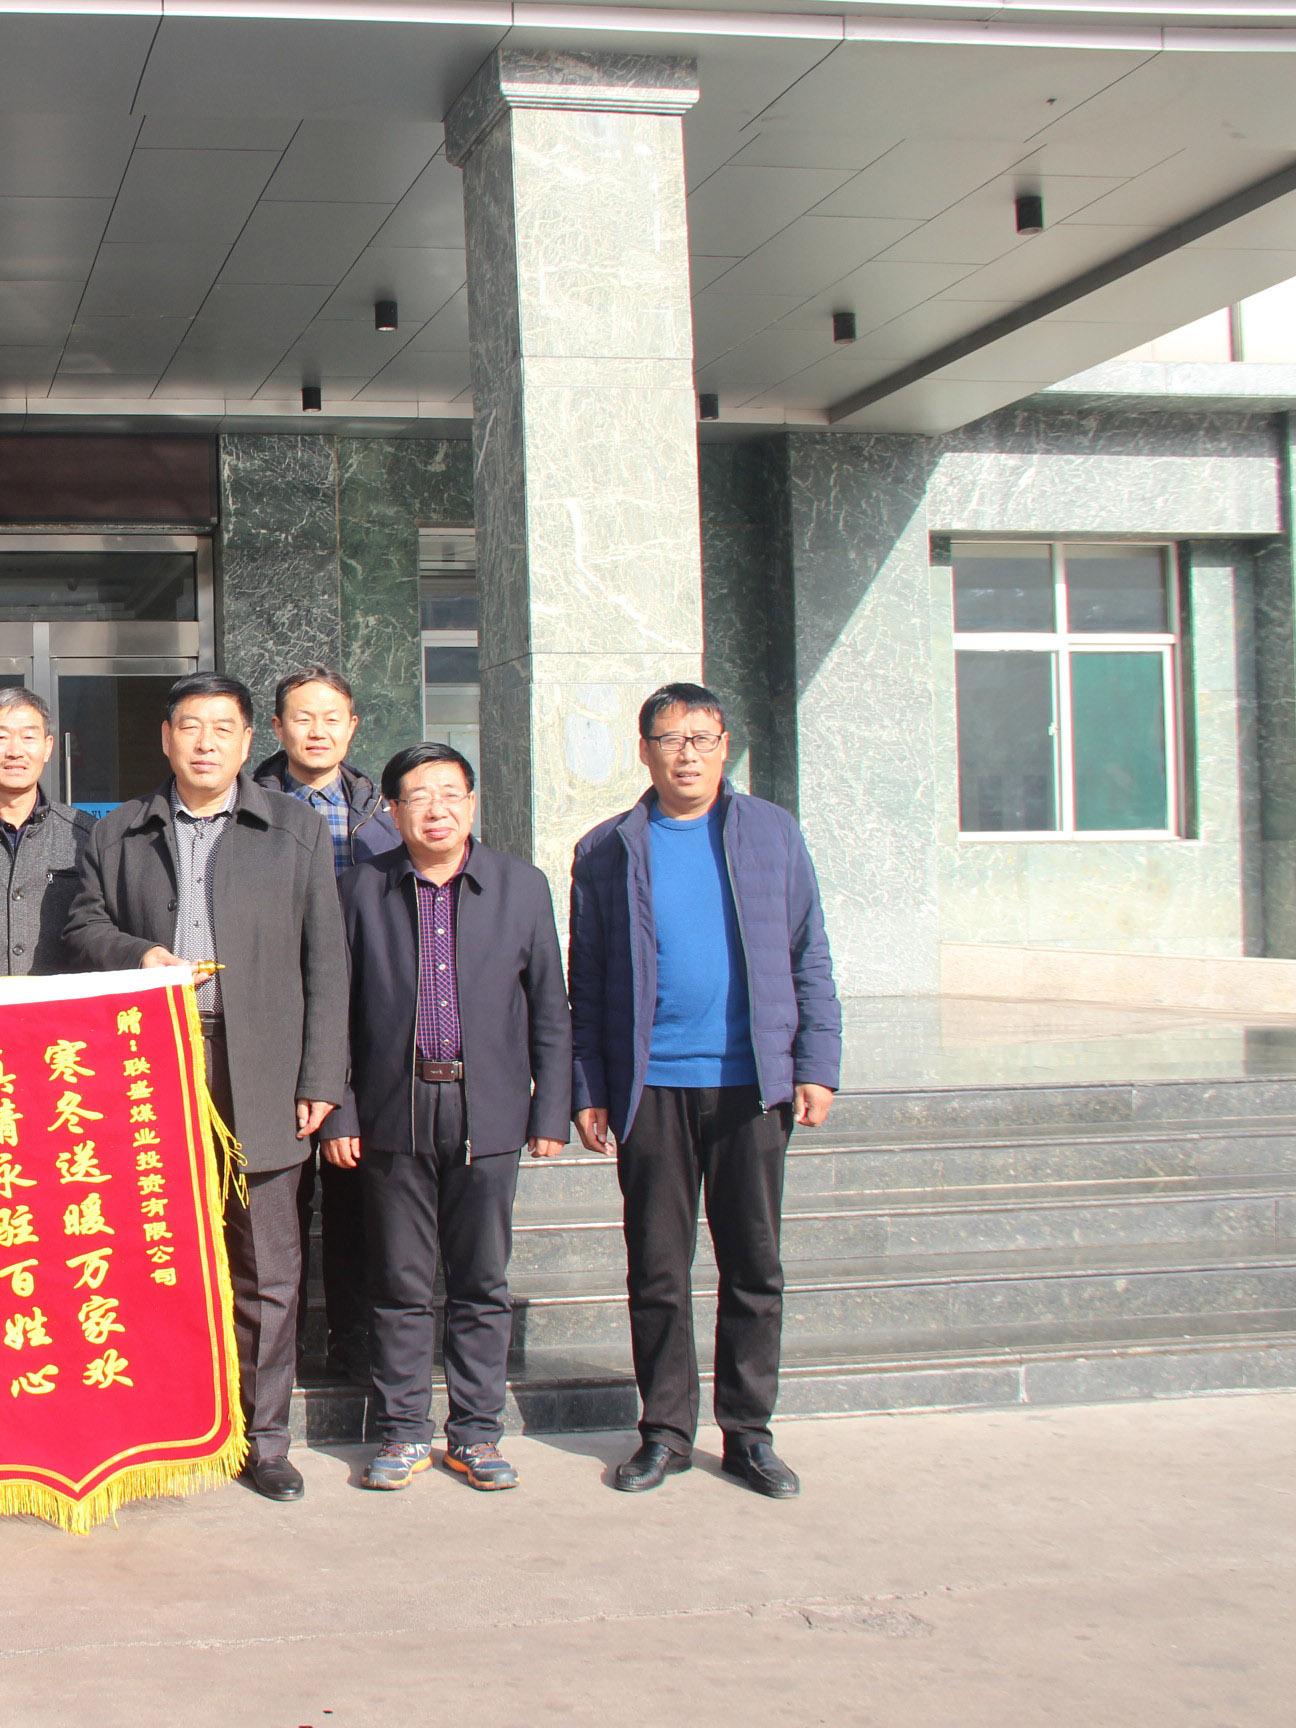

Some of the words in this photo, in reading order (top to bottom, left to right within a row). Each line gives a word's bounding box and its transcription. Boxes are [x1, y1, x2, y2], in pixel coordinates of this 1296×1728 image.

[43, 1039, 134, 1389] 寒冬送暖万家欢
